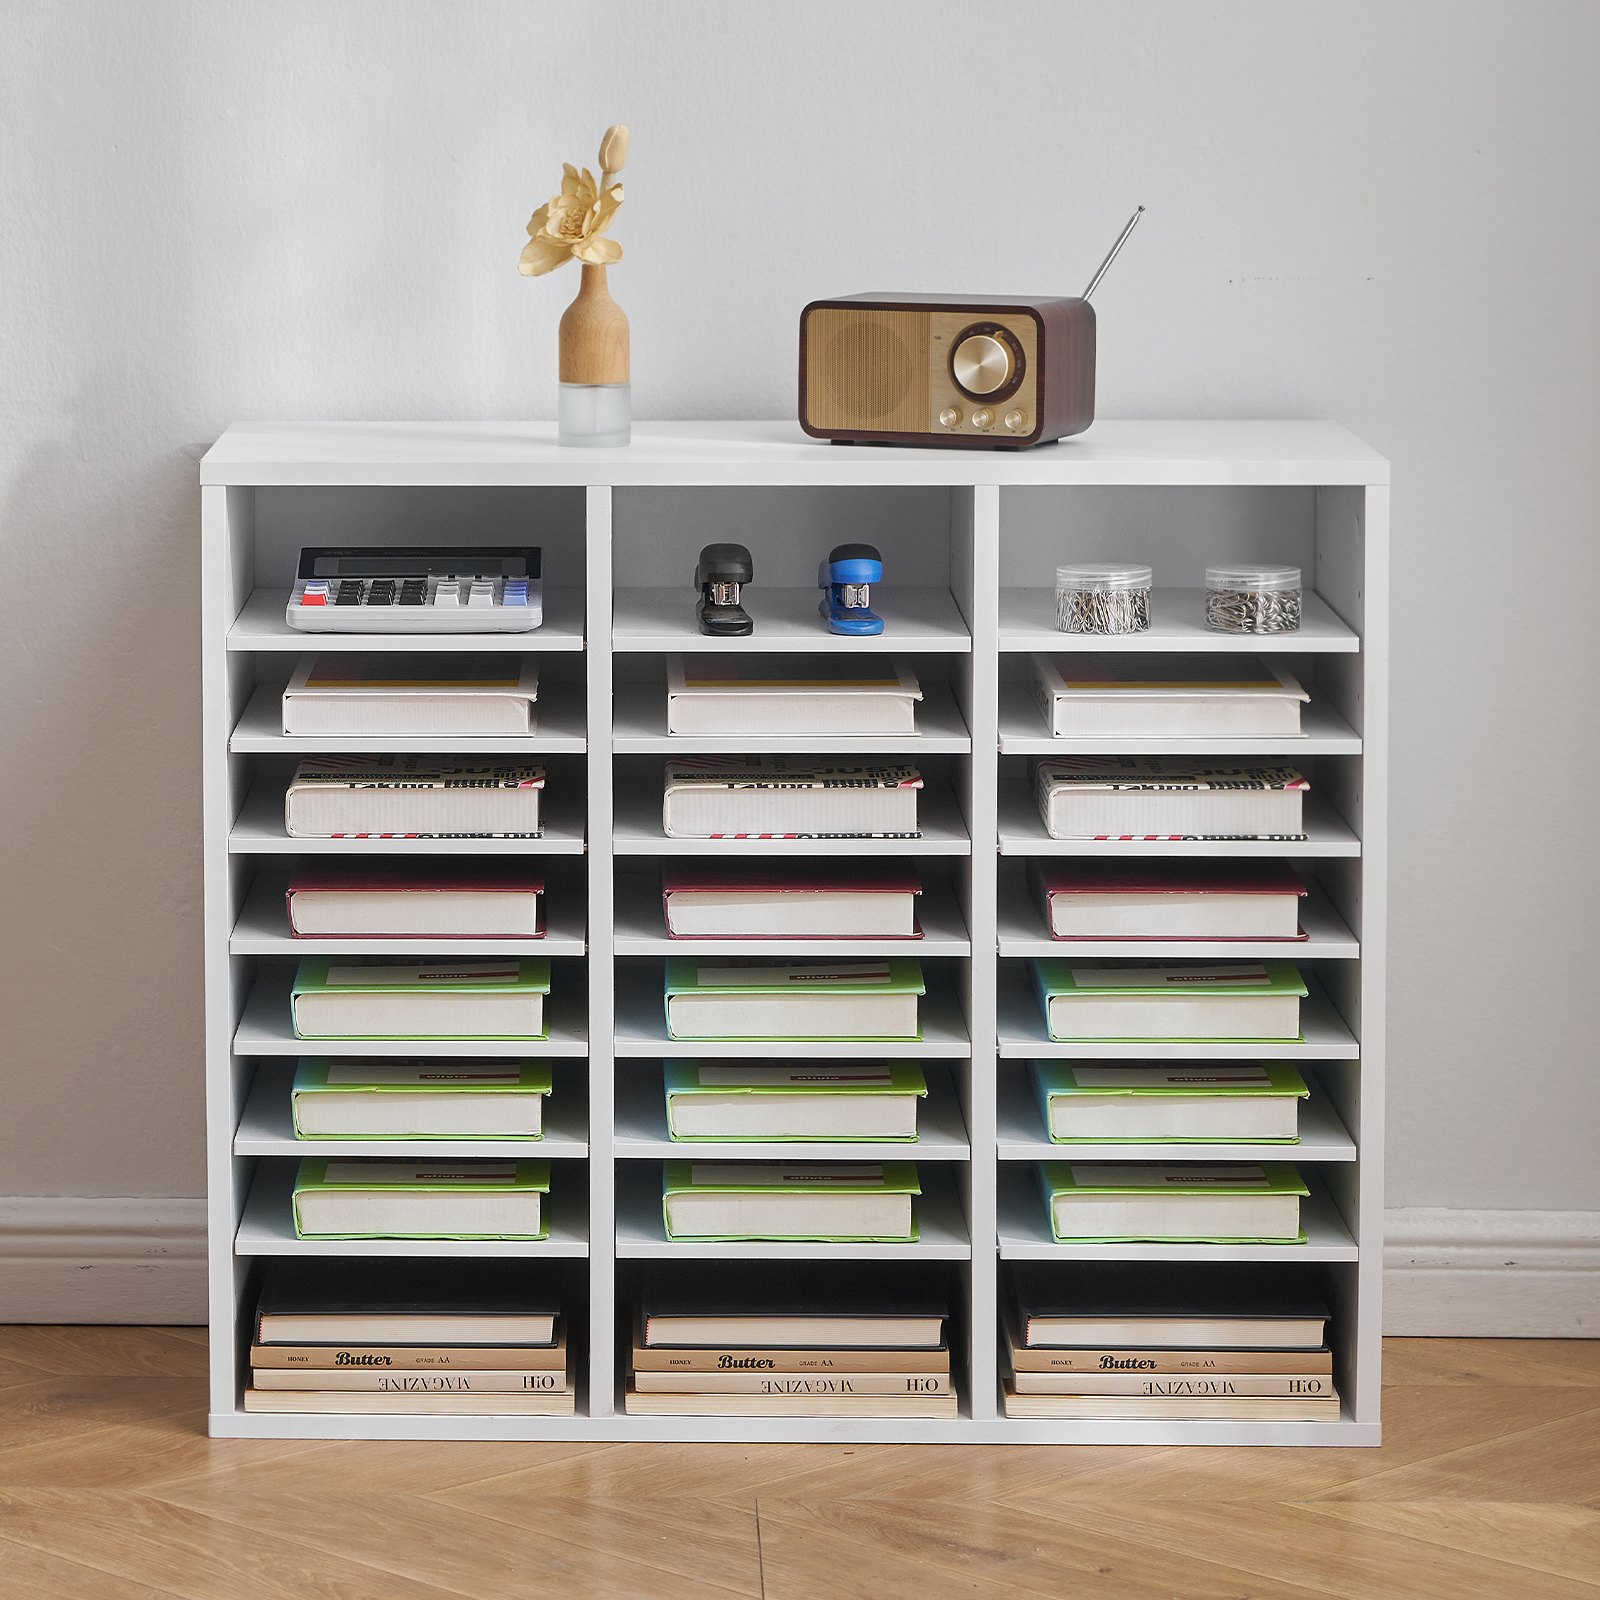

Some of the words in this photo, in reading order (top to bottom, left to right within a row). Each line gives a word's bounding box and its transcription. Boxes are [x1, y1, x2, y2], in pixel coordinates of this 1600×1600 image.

[335, 1352, 392, 1367] Butter
[717, 1355, 775, 1370] Butter
[1098, 1355, 1157, 1370] Butter
[378, 1377, 470, 1391] MAGAZINE
[761, 1380, 854, 1393] MAGAZINE
[1143, 1381, 1235, 1395] MAGAZINE
